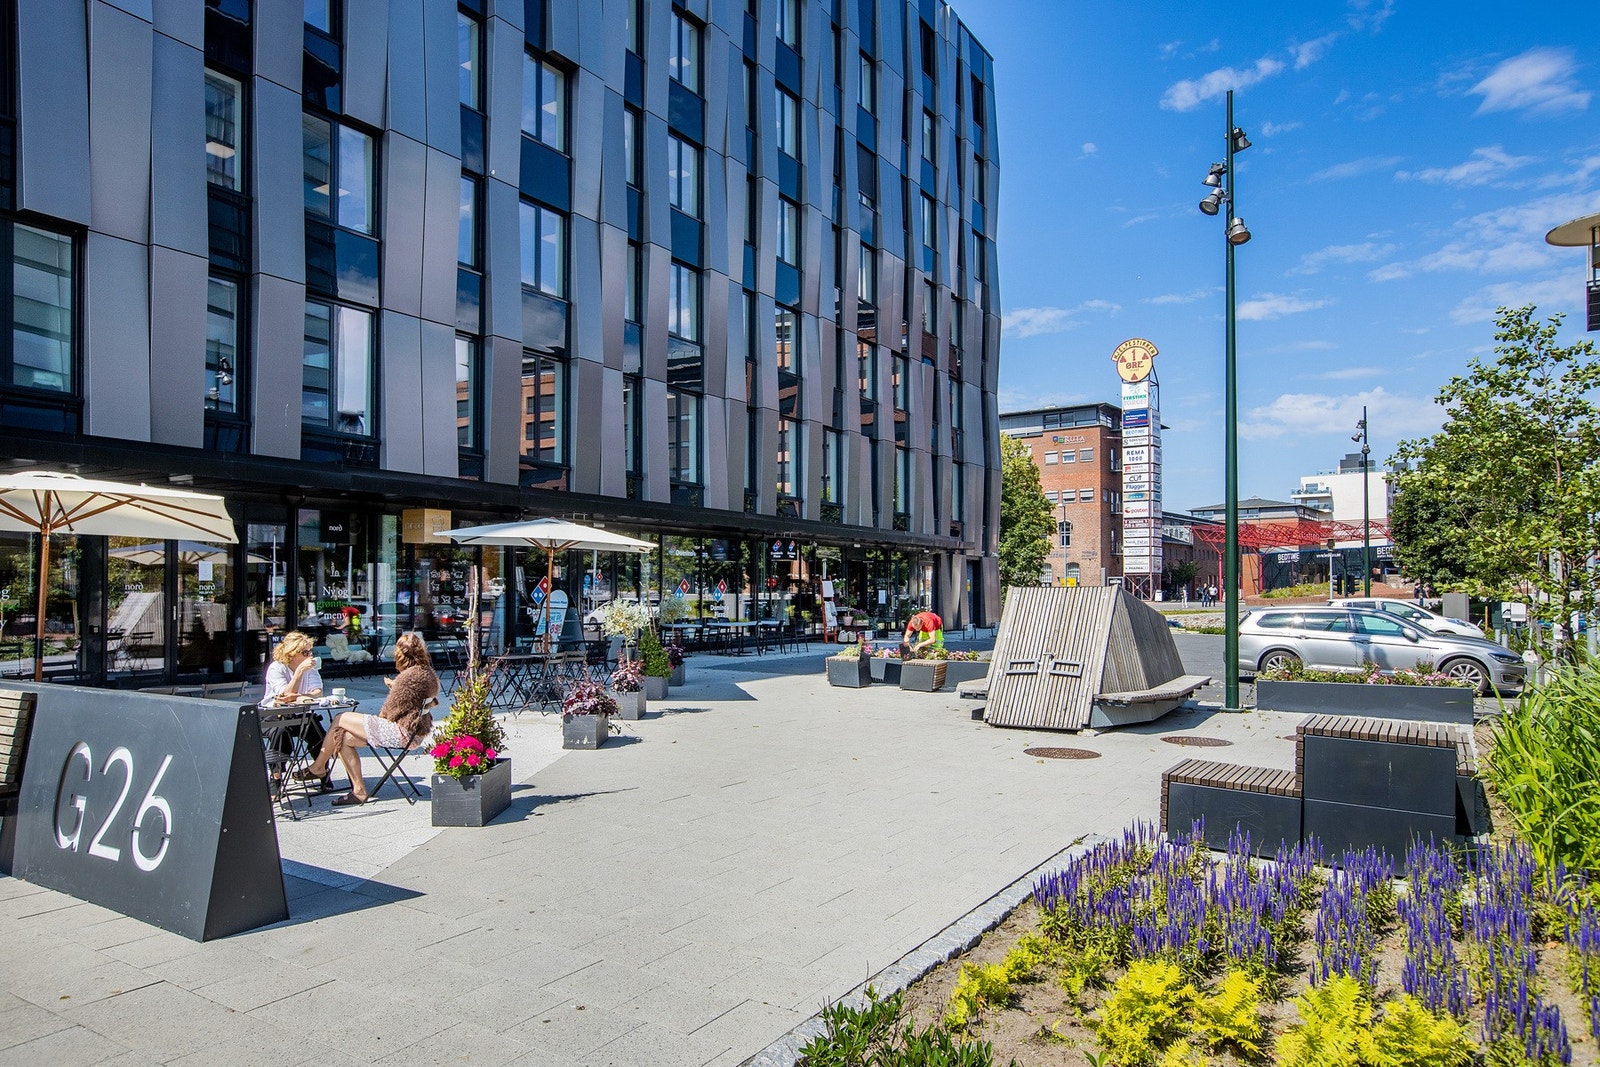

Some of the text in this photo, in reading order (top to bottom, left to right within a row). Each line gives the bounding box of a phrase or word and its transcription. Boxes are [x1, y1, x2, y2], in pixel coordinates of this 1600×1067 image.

[1131, 349, 1136, 361] 1
[323, 586, 349, 599] Ny og
[324, 612, 347, 621] meny
[54, 741, 174, 872] G26
